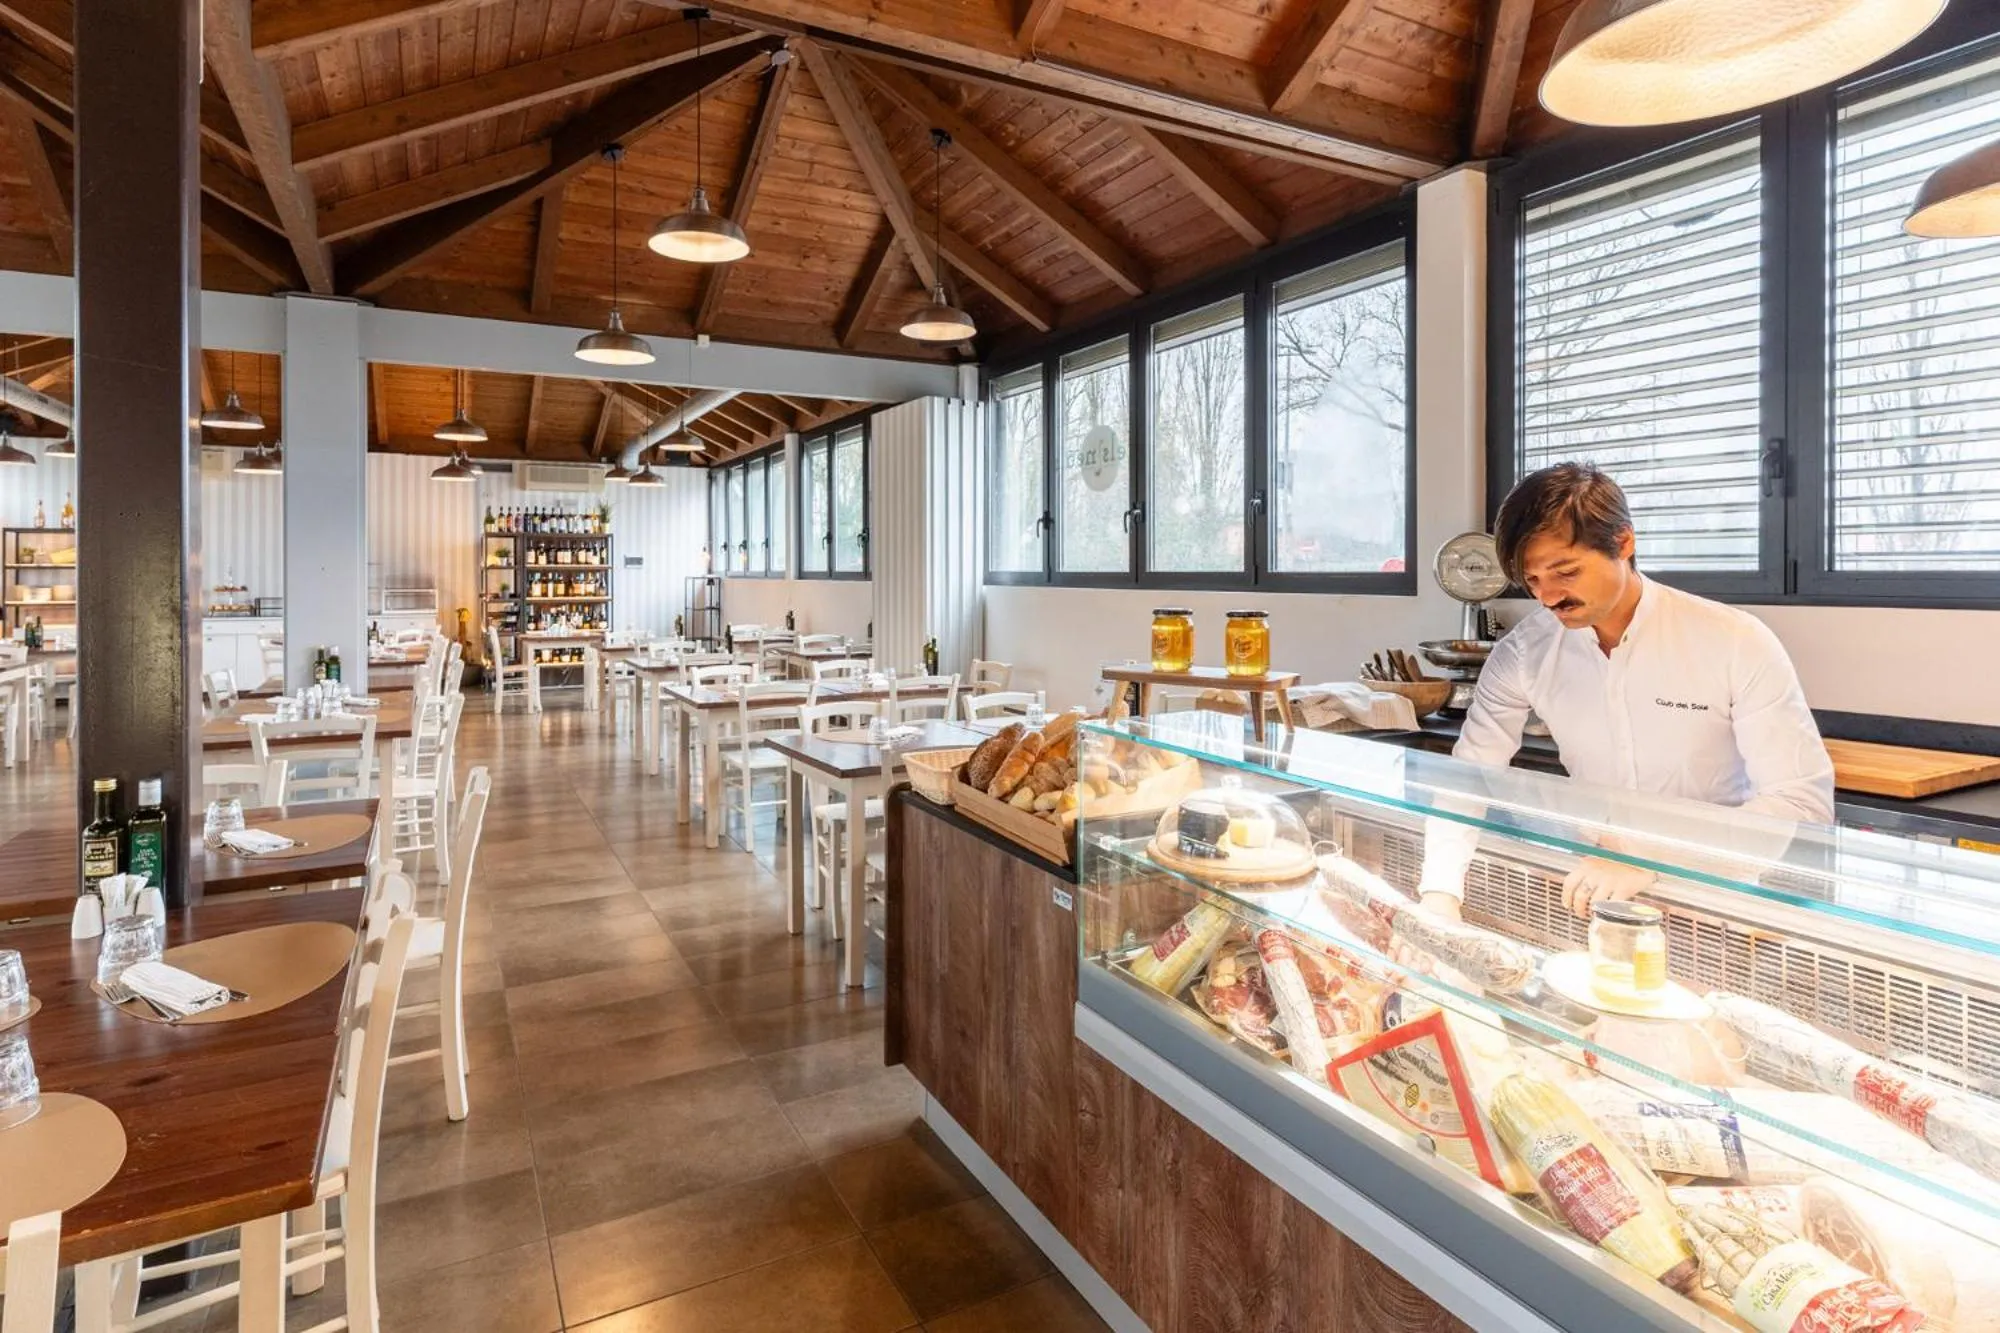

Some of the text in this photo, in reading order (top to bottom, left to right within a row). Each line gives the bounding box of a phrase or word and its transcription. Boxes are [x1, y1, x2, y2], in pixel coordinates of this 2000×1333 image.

[1655, 698, 1709, 711] Club del Sole
